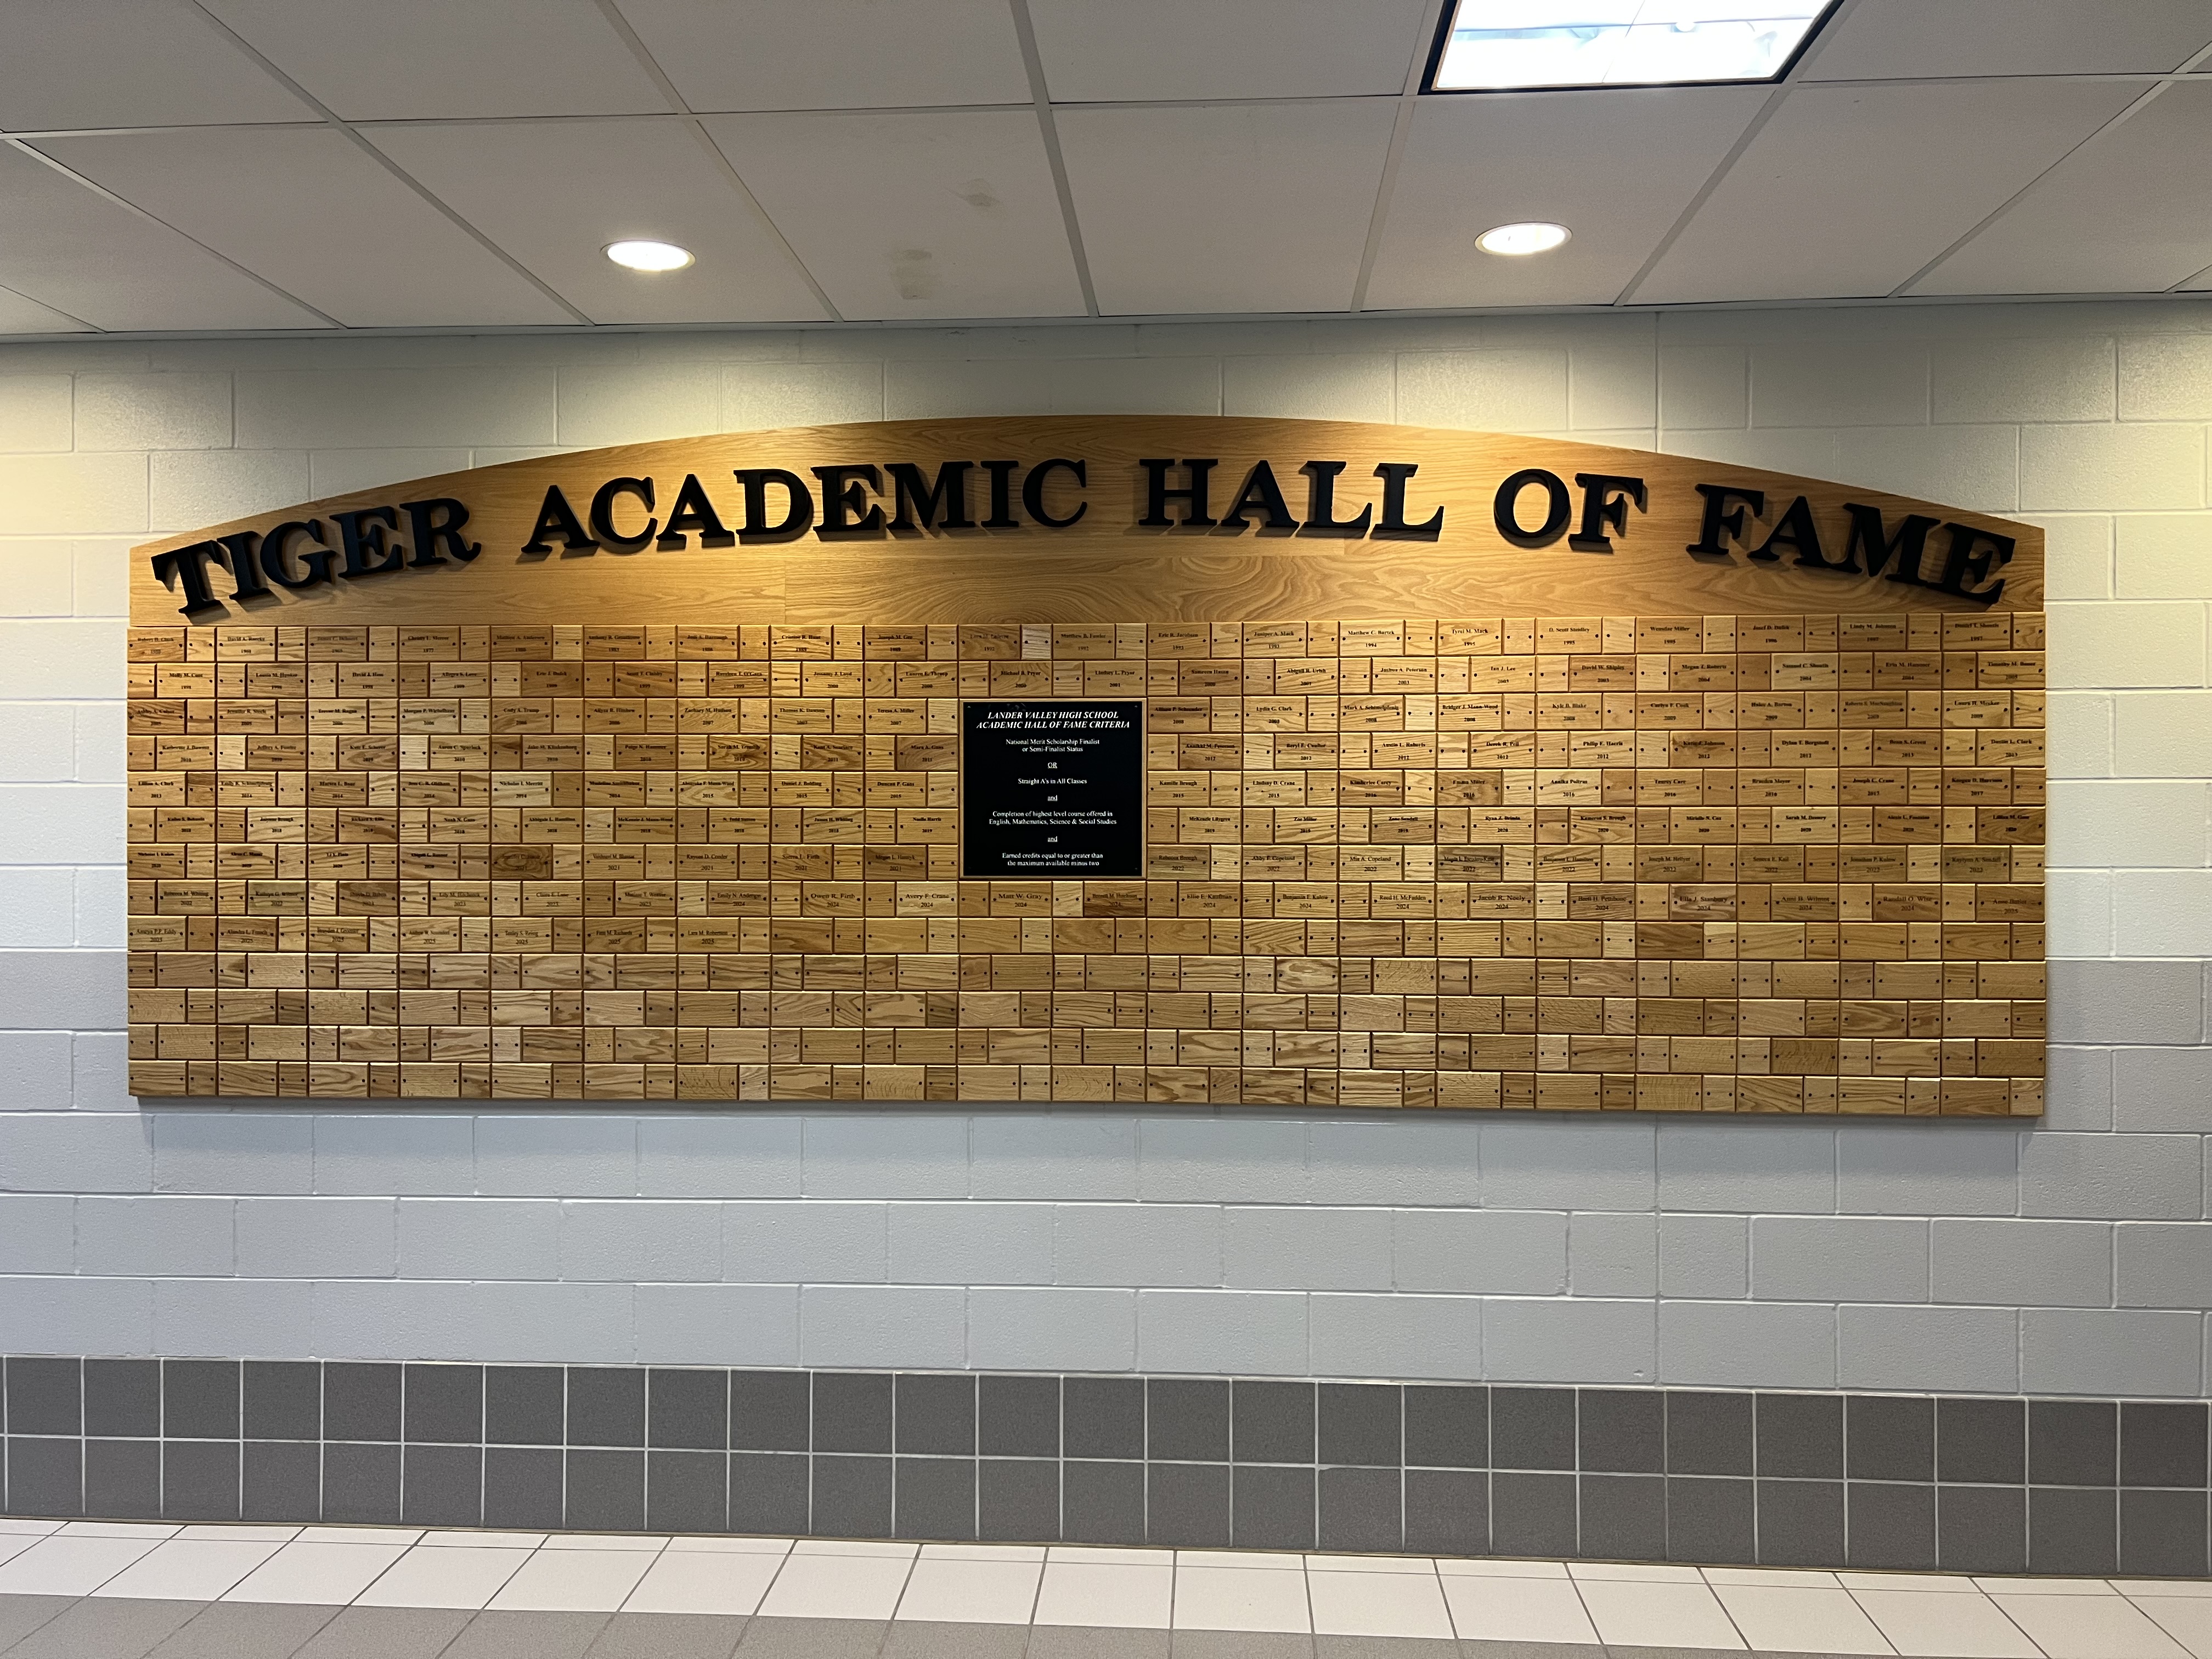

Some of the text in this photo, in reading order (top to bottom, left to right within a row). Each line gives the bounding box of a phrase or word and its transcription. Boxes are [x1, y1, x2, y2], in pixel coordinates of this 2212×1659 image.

[149, 457, 2017, 616] TIGER ACADEMIC HALL OF FAME
